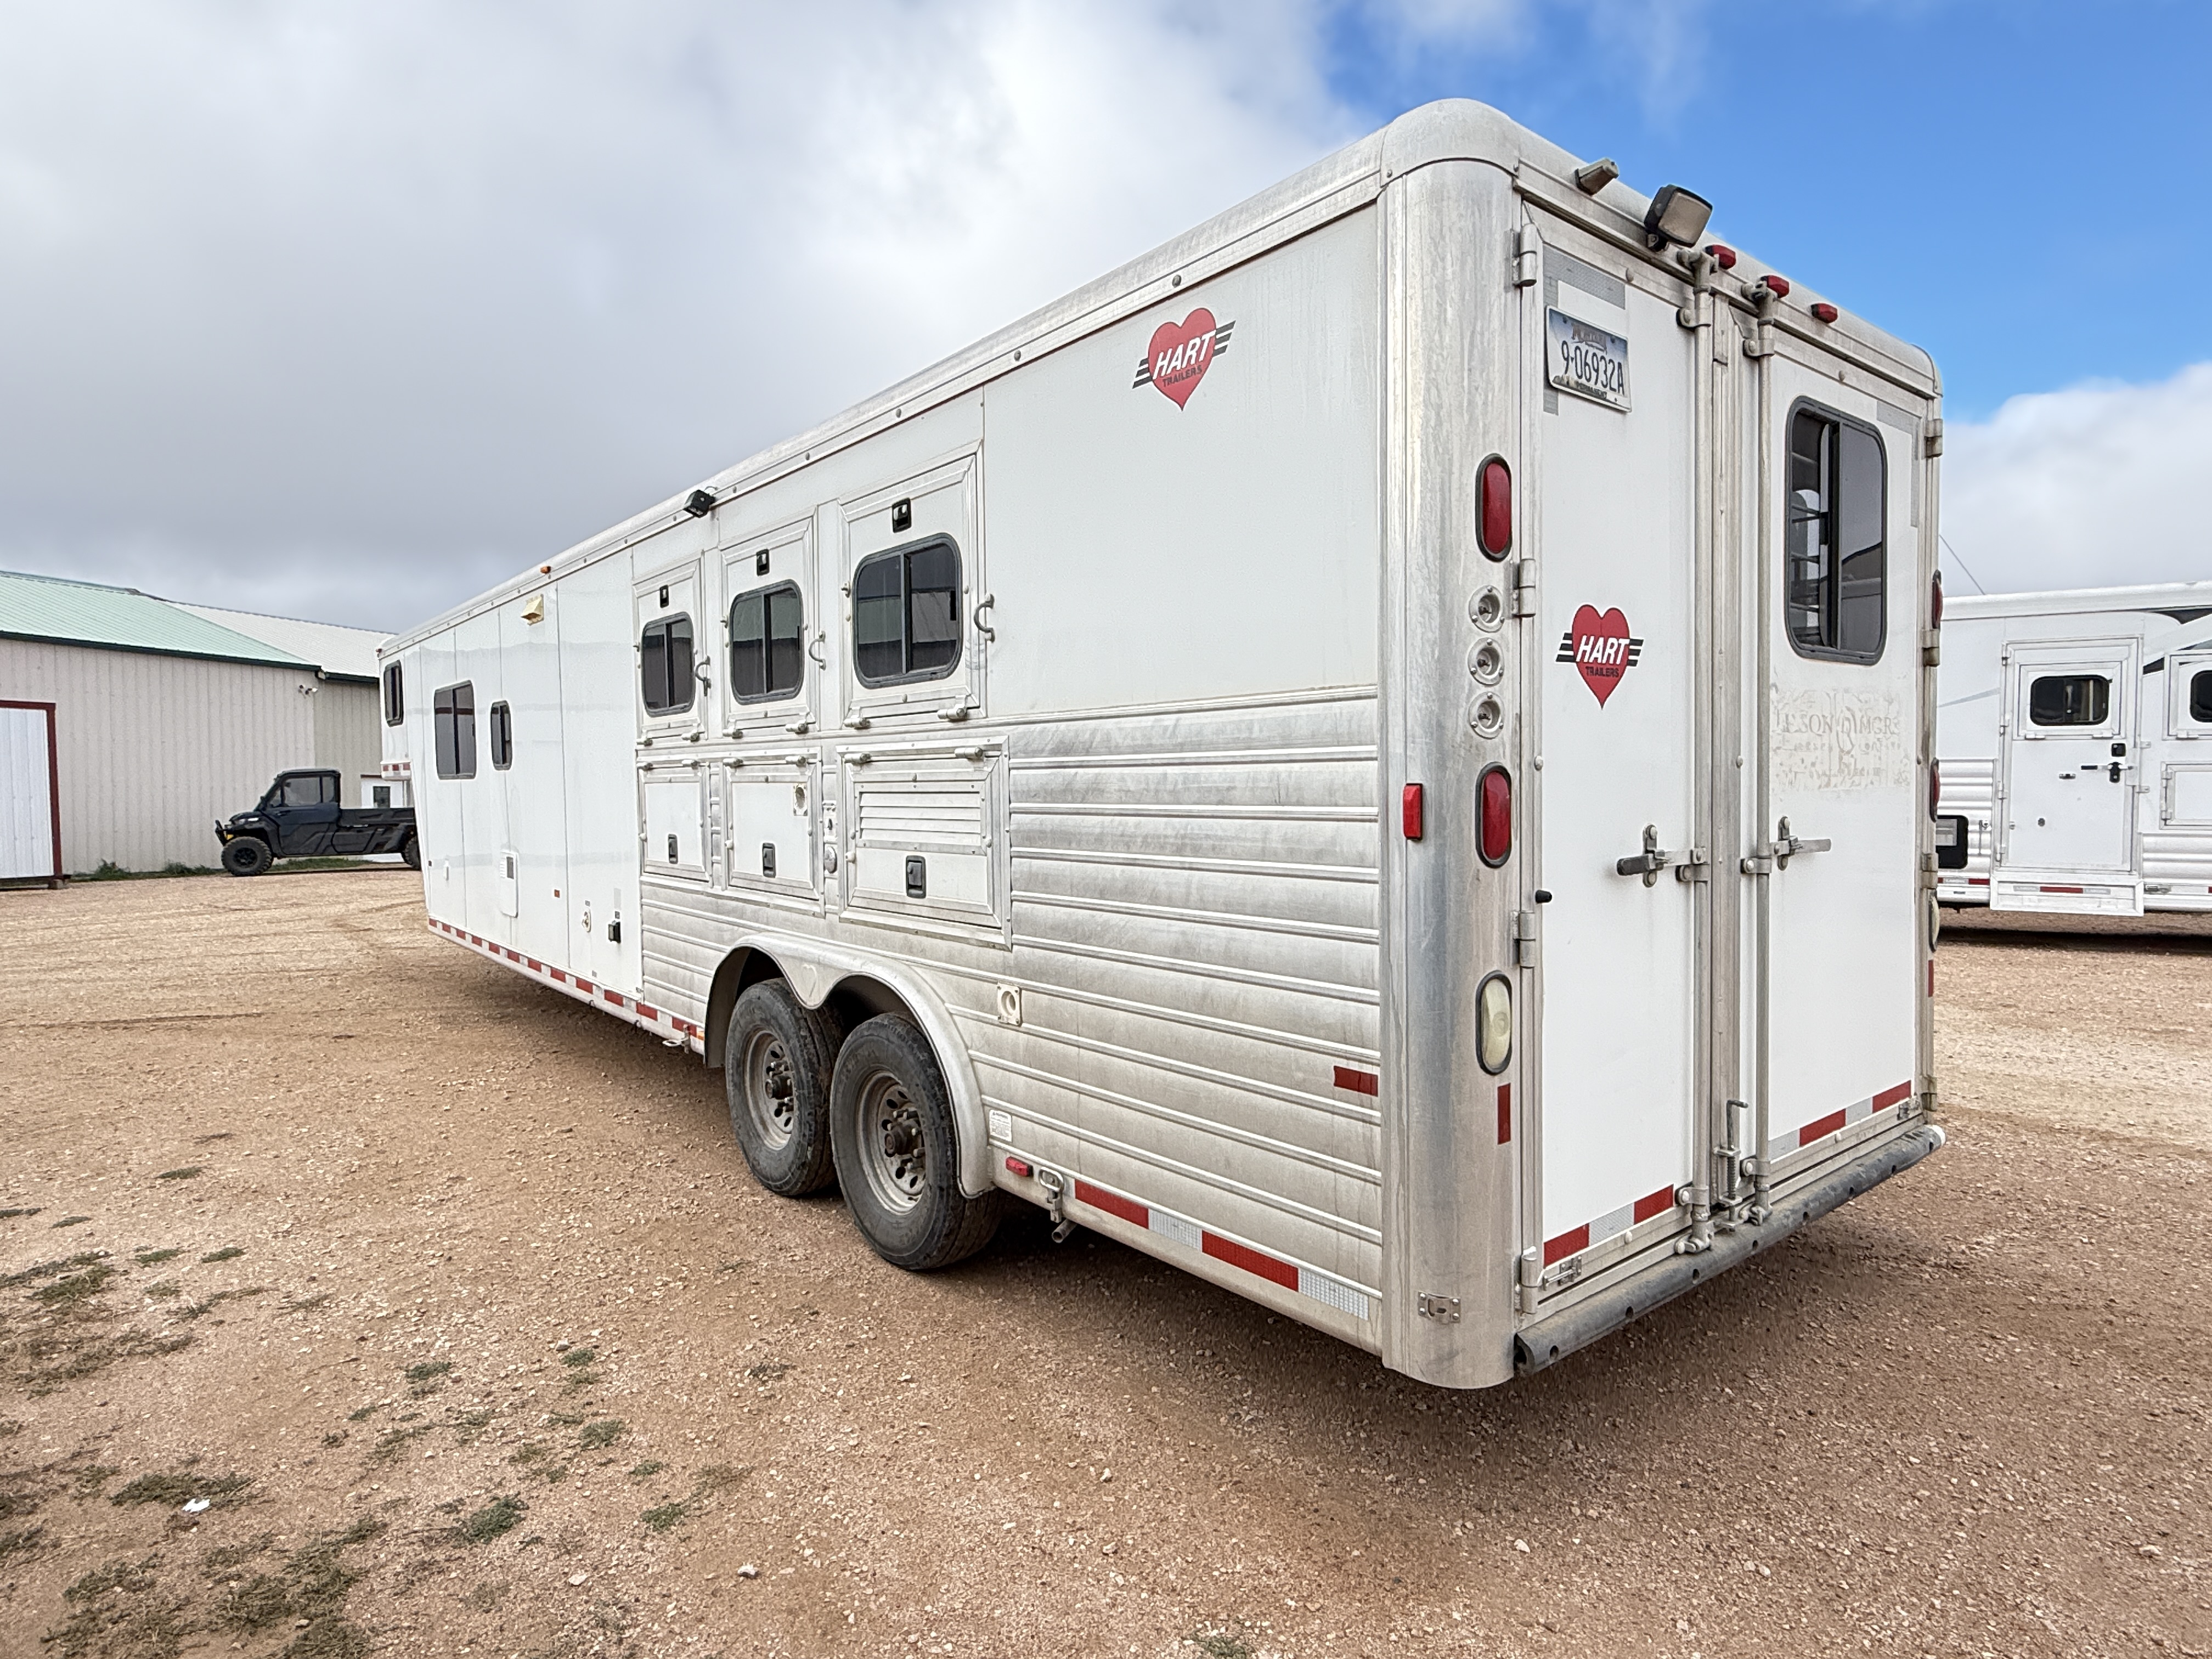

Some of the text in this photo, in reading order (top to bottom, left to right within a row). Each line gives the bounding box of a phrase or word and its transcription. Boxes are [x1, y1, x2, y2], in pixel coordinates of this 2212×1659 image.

[1153, 330, 1216, 380] HART
[1163, 365, 1202, 387] TRAILERS
[1576, 635, 1630, 664] HART
[1585, 666, 1620, 678] TRAILERS
